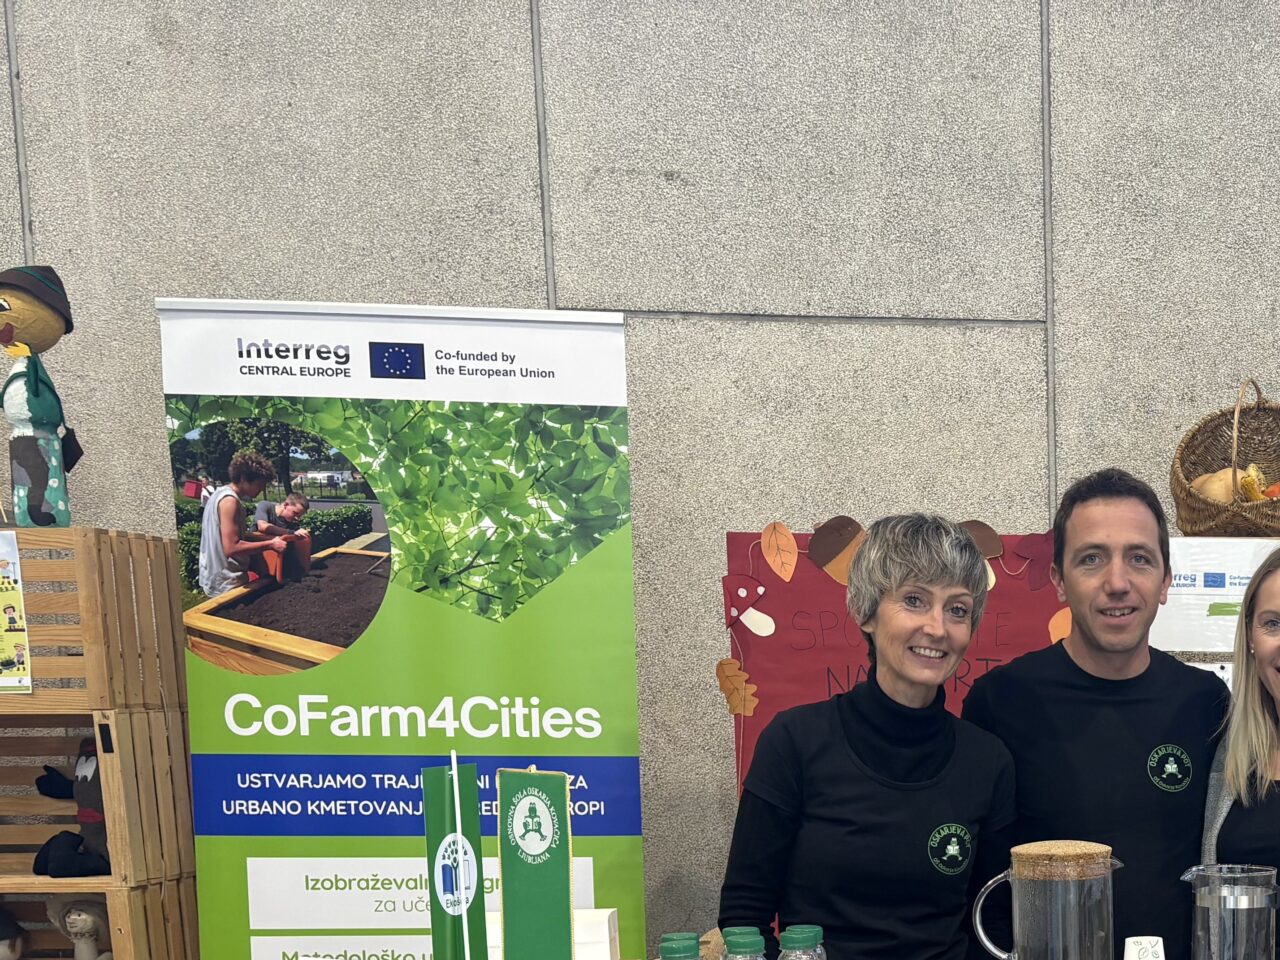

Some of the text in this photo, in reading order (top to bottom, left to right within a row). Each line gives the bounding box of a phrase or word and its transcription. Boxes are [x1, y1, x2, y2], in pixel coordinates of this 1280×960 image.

[237, 338, 350, 366] Interreg
[435, 350, 516, 365] Co-funded by
[239, 365, 351, 378] CENTRAL EUROPE
[436, 365, 555, 379] the European Union
[224, 693, 603, 739] CoFarm4Cities
[237, 773, 367, 789] USTVARJAMO
[222, 799, 302, 815] URBANO
[307, 800, 423, 816] KMETOVANJ
[304, 874, 428, 891] Izobraževal
[374, 900, 396, 913] za
